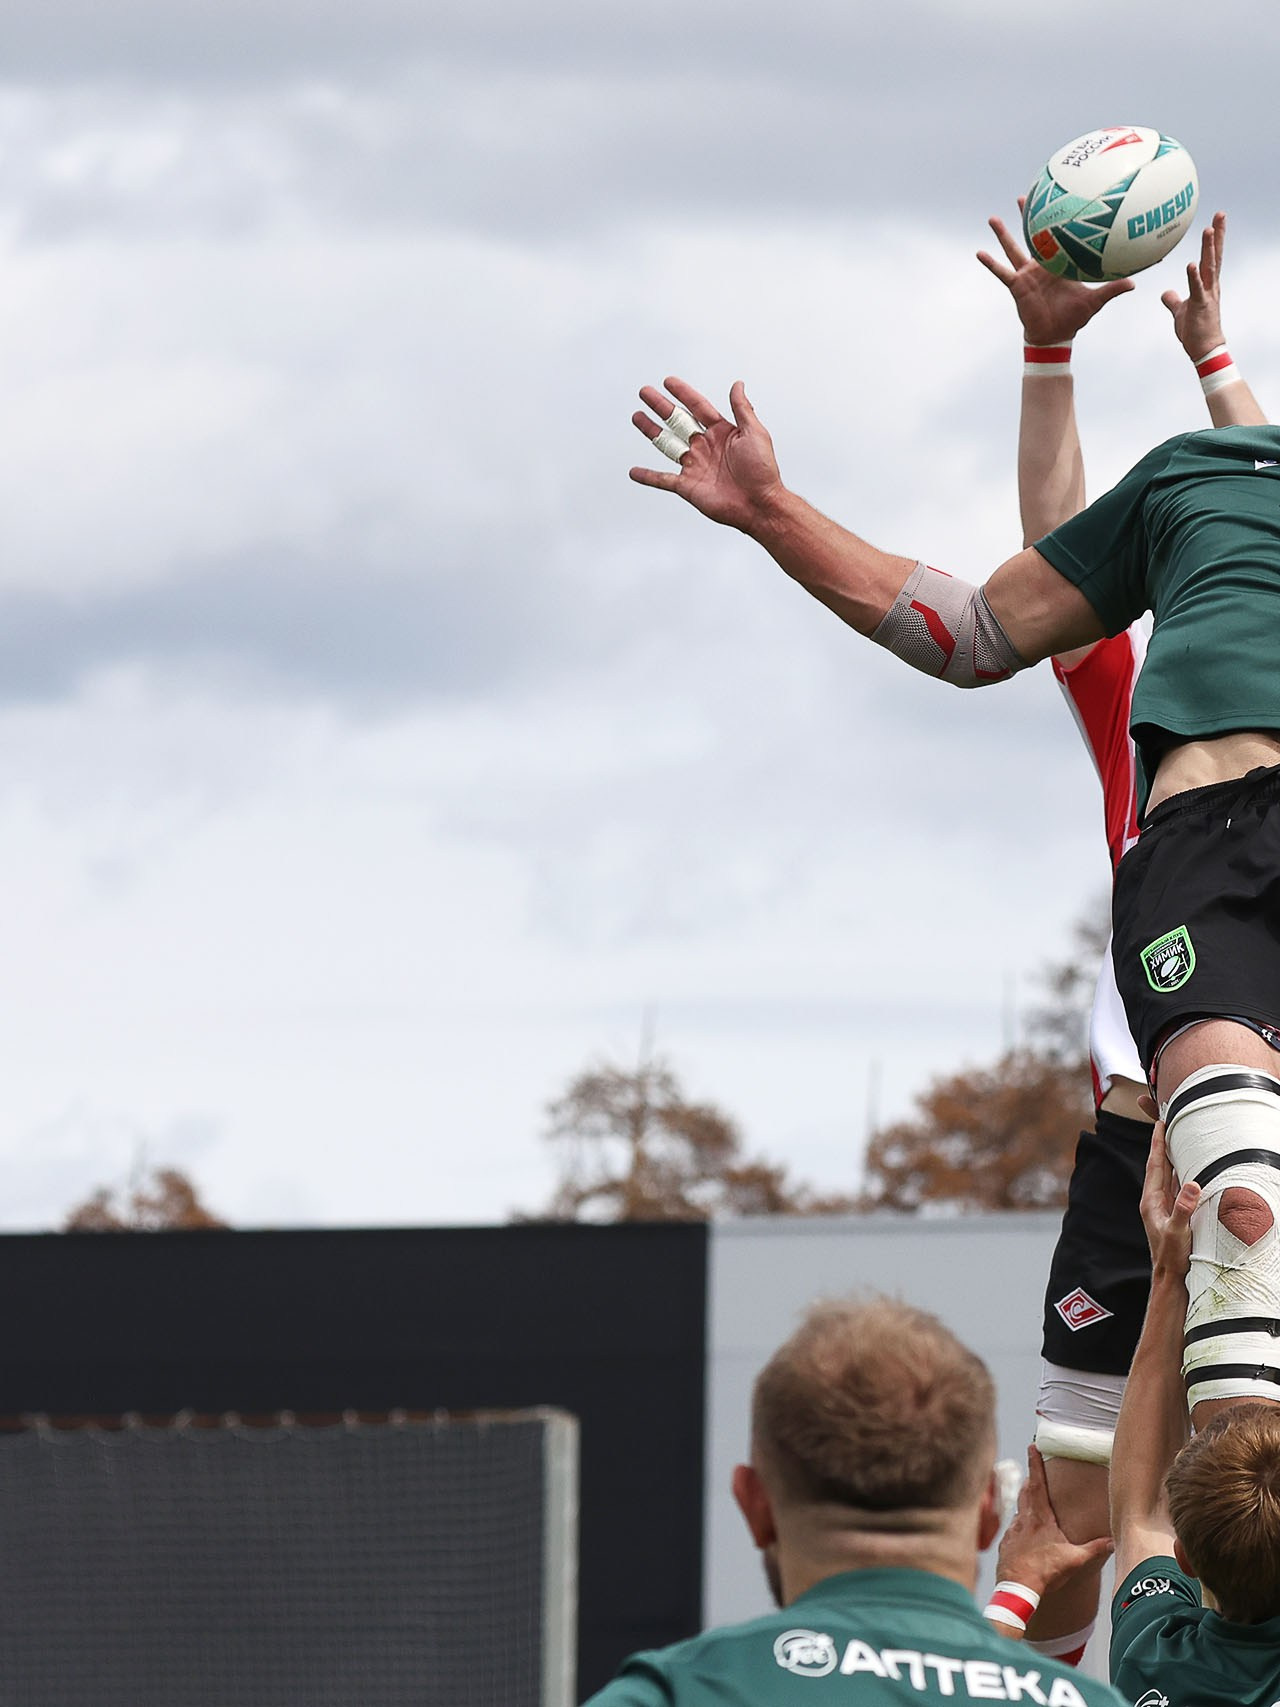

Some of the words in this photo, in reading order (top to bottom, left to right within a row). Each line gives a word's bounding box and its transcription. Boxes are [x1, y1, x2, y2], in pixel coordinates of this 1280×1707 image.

[1127, 182, 1194, 240] СИБУР
[1150, 942, 1184, 969] ХИМИК
[839, 1638, 1089, 1707] АПТЕКА
